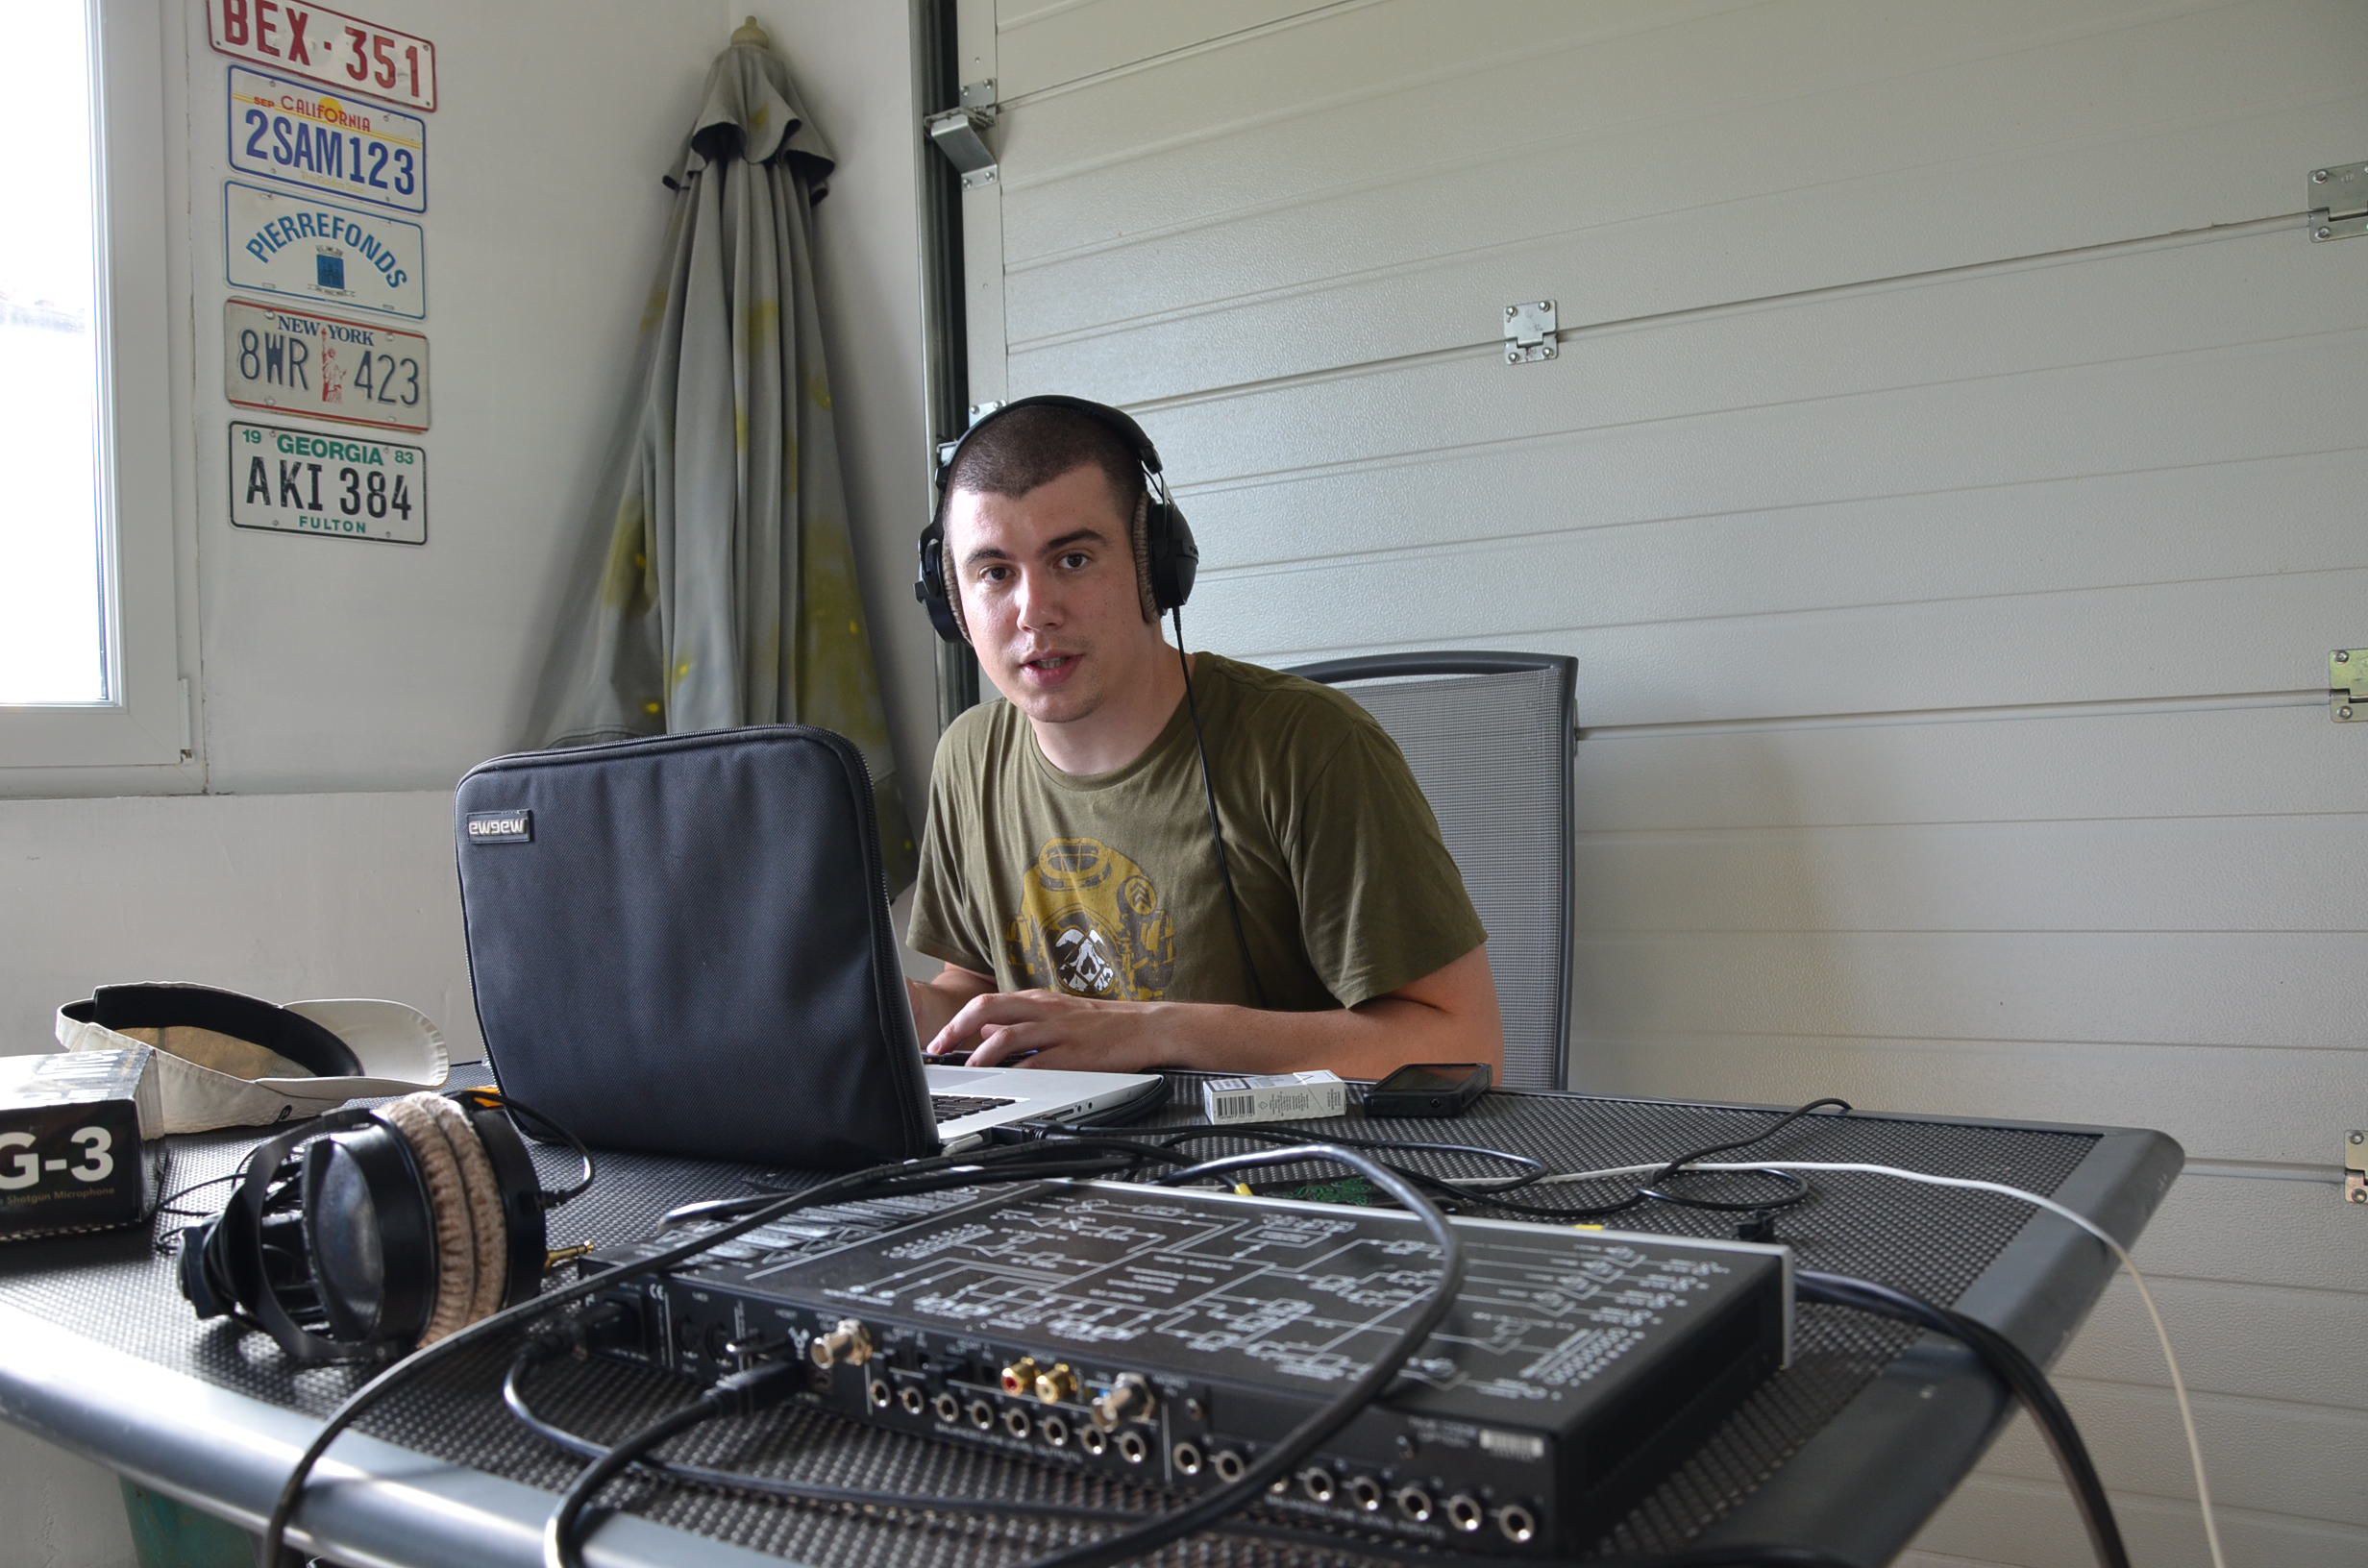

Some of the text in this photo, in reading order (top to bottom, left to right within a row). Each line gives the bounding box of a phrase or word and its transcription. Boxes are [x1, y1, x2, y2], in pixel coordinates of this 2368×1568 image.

[253, 96, 372, 133] SEP CALIFORNIA
[245, 109, 415, 196] 2SAM123
[245, 212, 407, 288] PIERREFONDS
[278, 315, 375, 347] NEW YORK
[239, 329, 420, 405] 8WR 423
[242, 429, 414, 466] 19 GEORGIA 83
[246, 456, 411, 521] AKI 384
[299, 515, 367, 534] FULTON
[7, 1192, 51, 1206] Shotgun
[54, 1187, 115, 1200] Microphone
